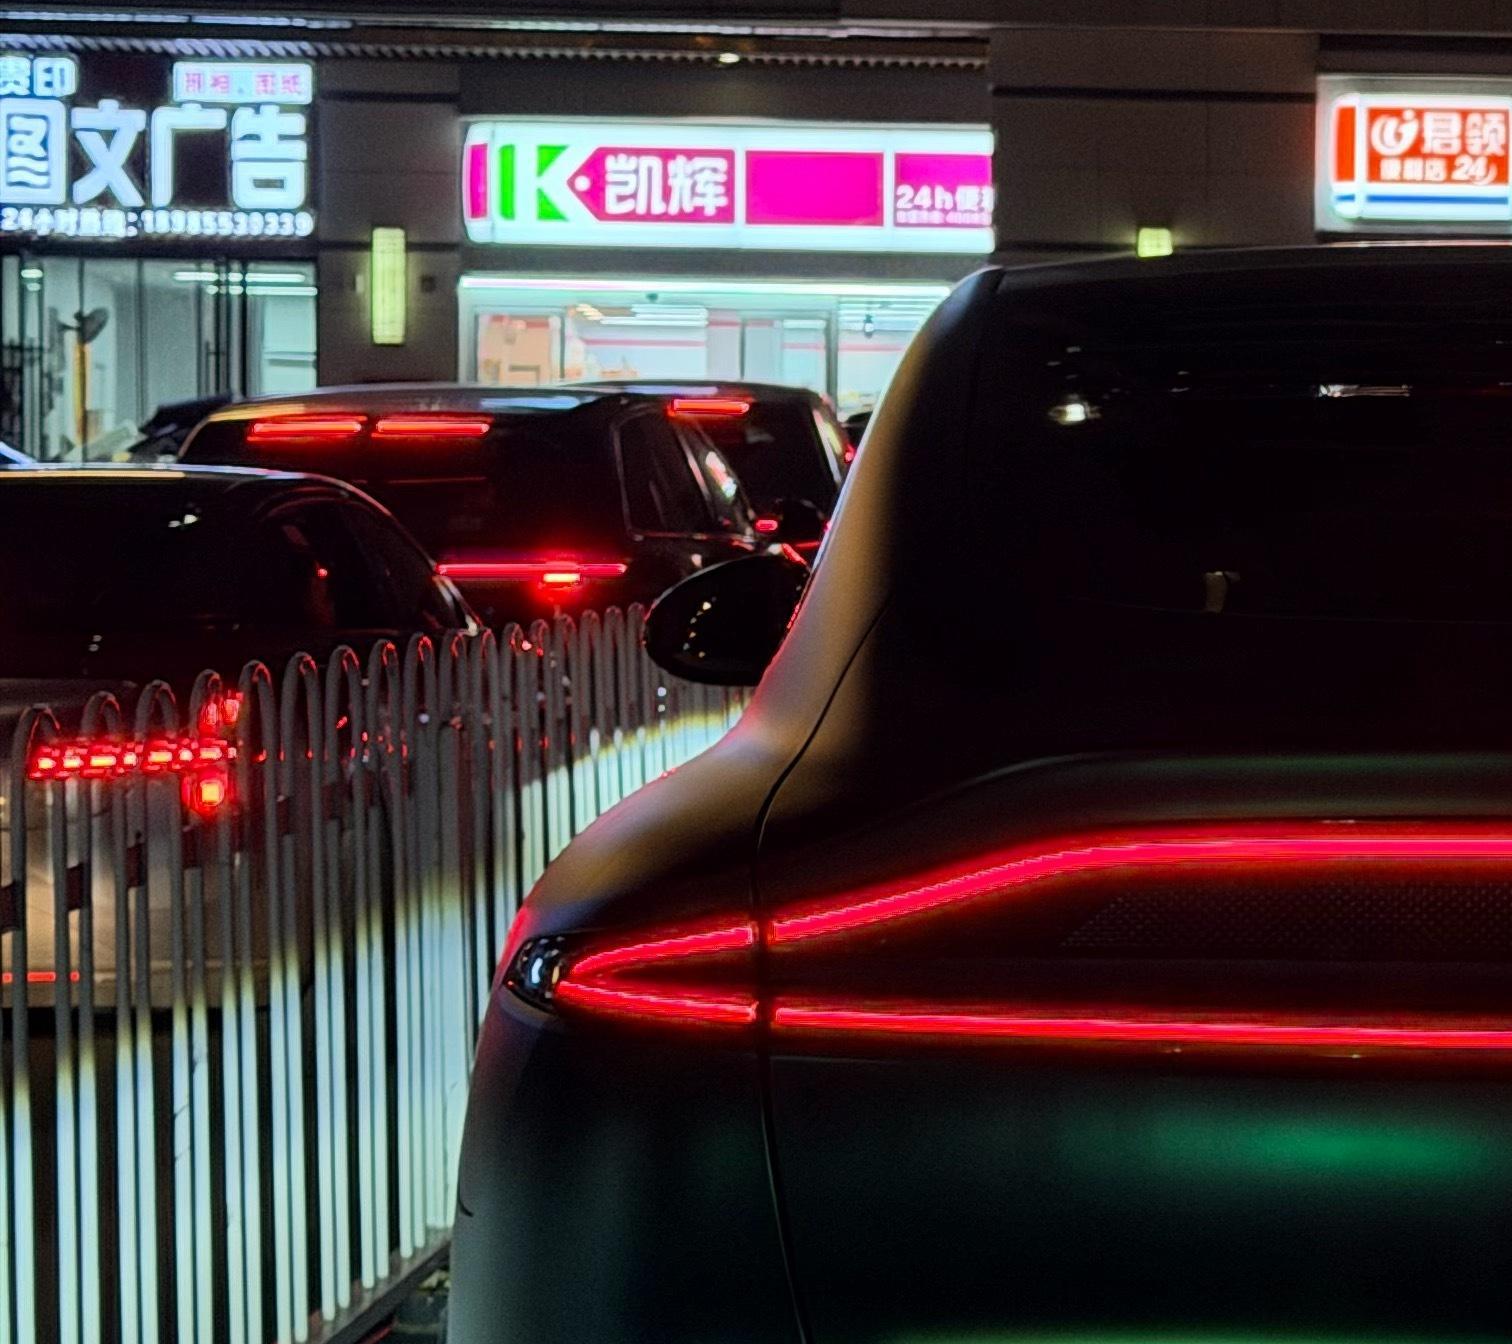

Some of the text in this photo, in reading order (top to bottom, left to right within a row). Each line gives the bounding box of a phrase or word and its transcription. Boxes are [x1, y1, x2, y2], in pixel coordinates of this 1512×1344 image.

[0, 98, 307, 209] 图文广告
[605, 154, 728, 217] 凯辉
